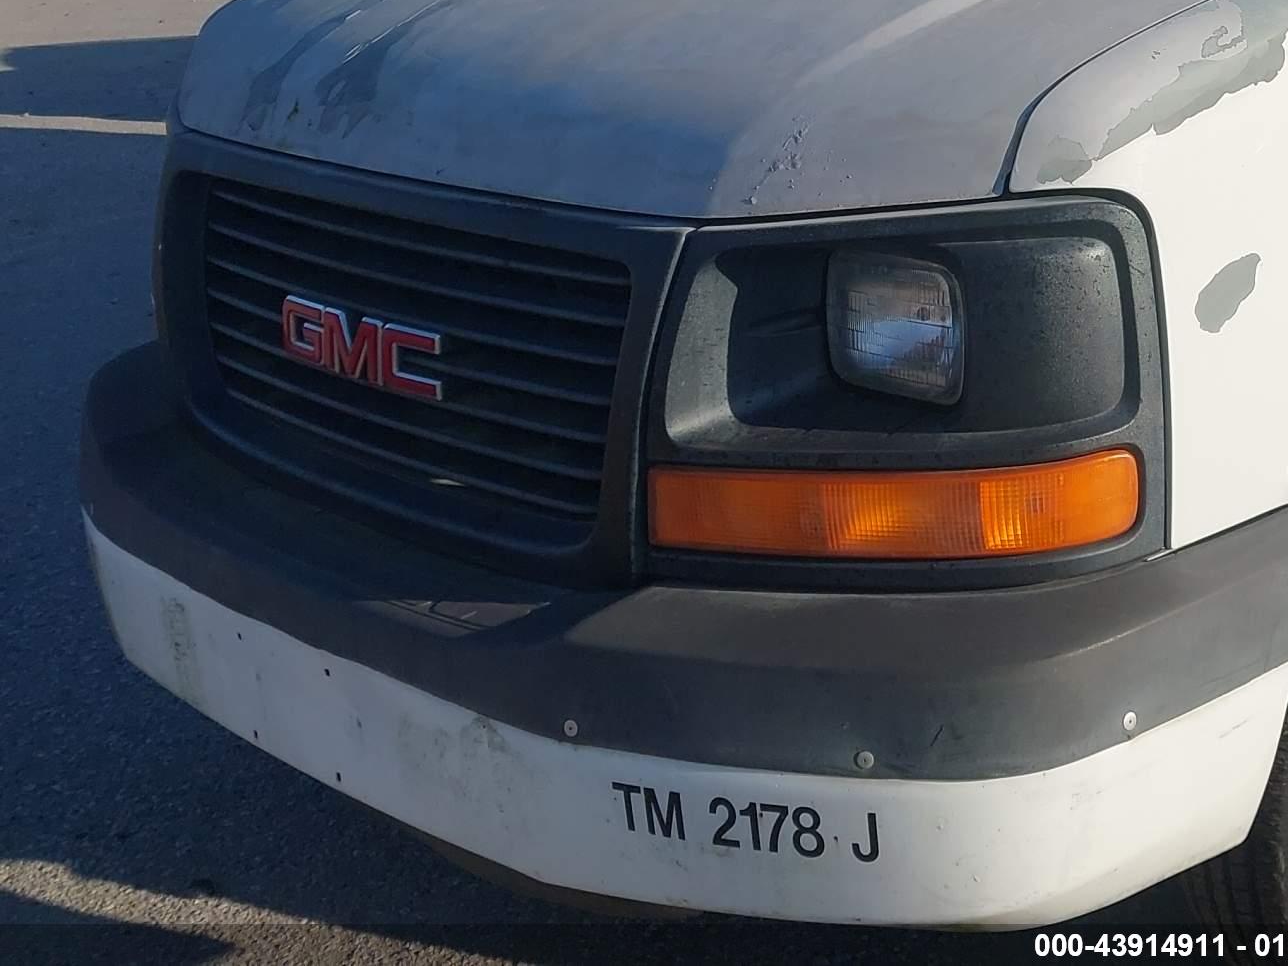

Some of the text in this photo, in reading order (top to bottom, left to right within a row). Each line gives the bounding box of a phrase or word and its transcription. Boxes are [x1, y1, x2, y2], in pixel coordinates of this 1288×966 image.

[282, 295, 443, 402] GMC
[611, 781, 881, 863] TM 2178 J
